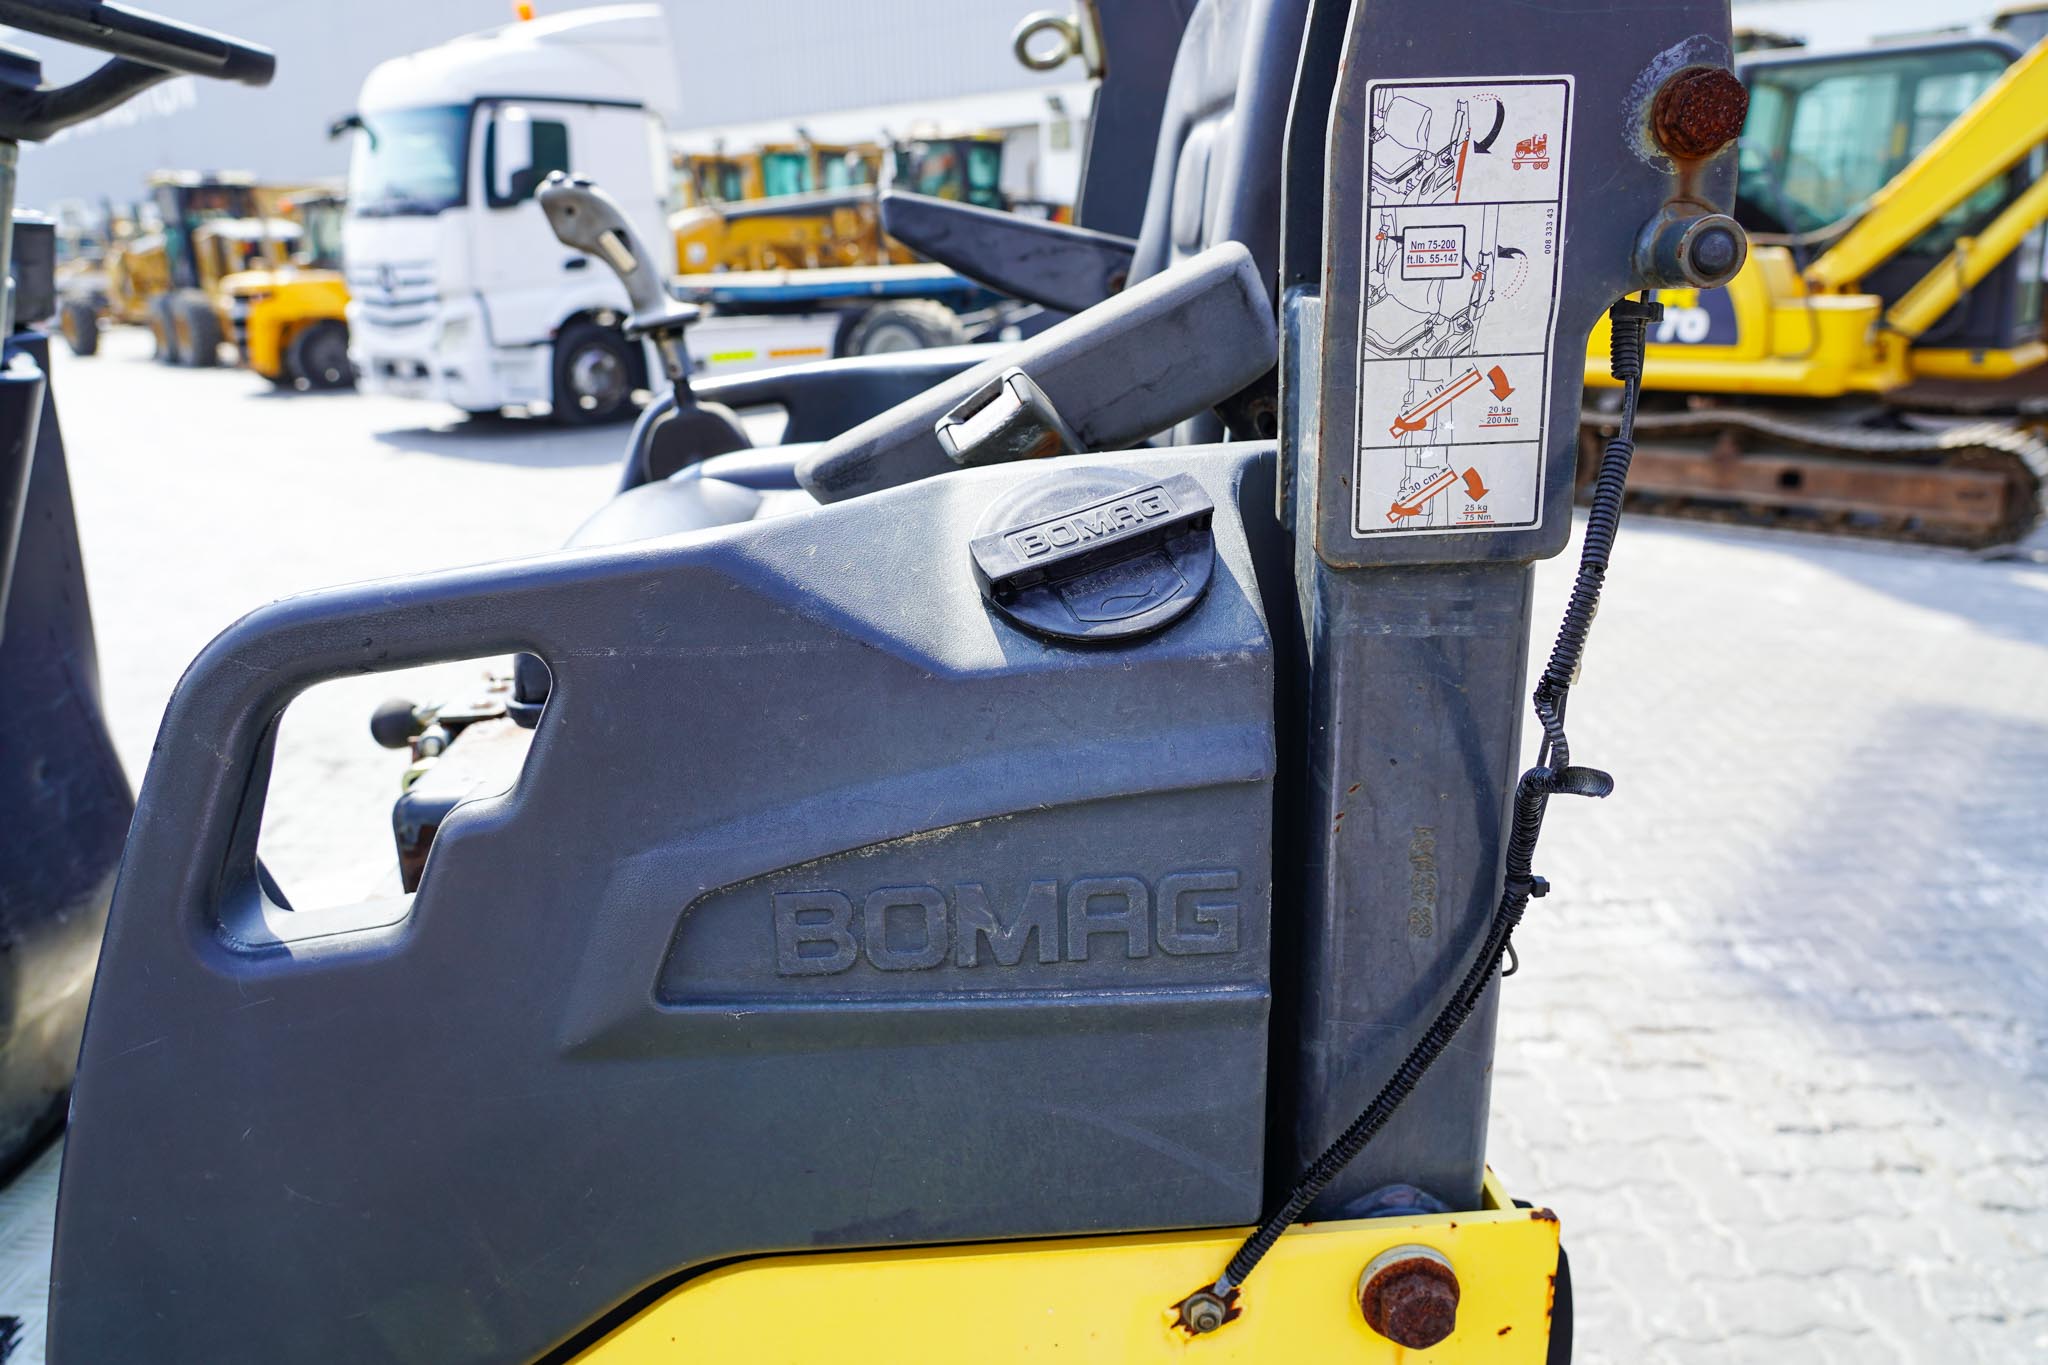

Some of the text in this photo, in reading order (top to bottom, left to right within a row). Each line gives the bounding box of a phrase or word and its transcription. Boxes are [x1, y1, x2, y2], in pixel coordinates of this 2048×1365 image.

[1544, 208, 1554, 255] 008 333 43
[1410, 239, 1456, 250] Nm 75-200
[1406, 253, 1459, 265] ft.lb. 55-147
[1434, 384, 1445, 394] m
[1488, 405, 1512, 415] 20 kg
[1486, 416, 1502, 424] 200
[1504, 416, 1519, 424] Nm
[1408, 472, 1439, 494] 30 cm
[1464, 503, 1488, 513] 25 kg
[1014, 493, 1170, 559] BOMAG
[772, 869, 1240, 977] BOMAG
